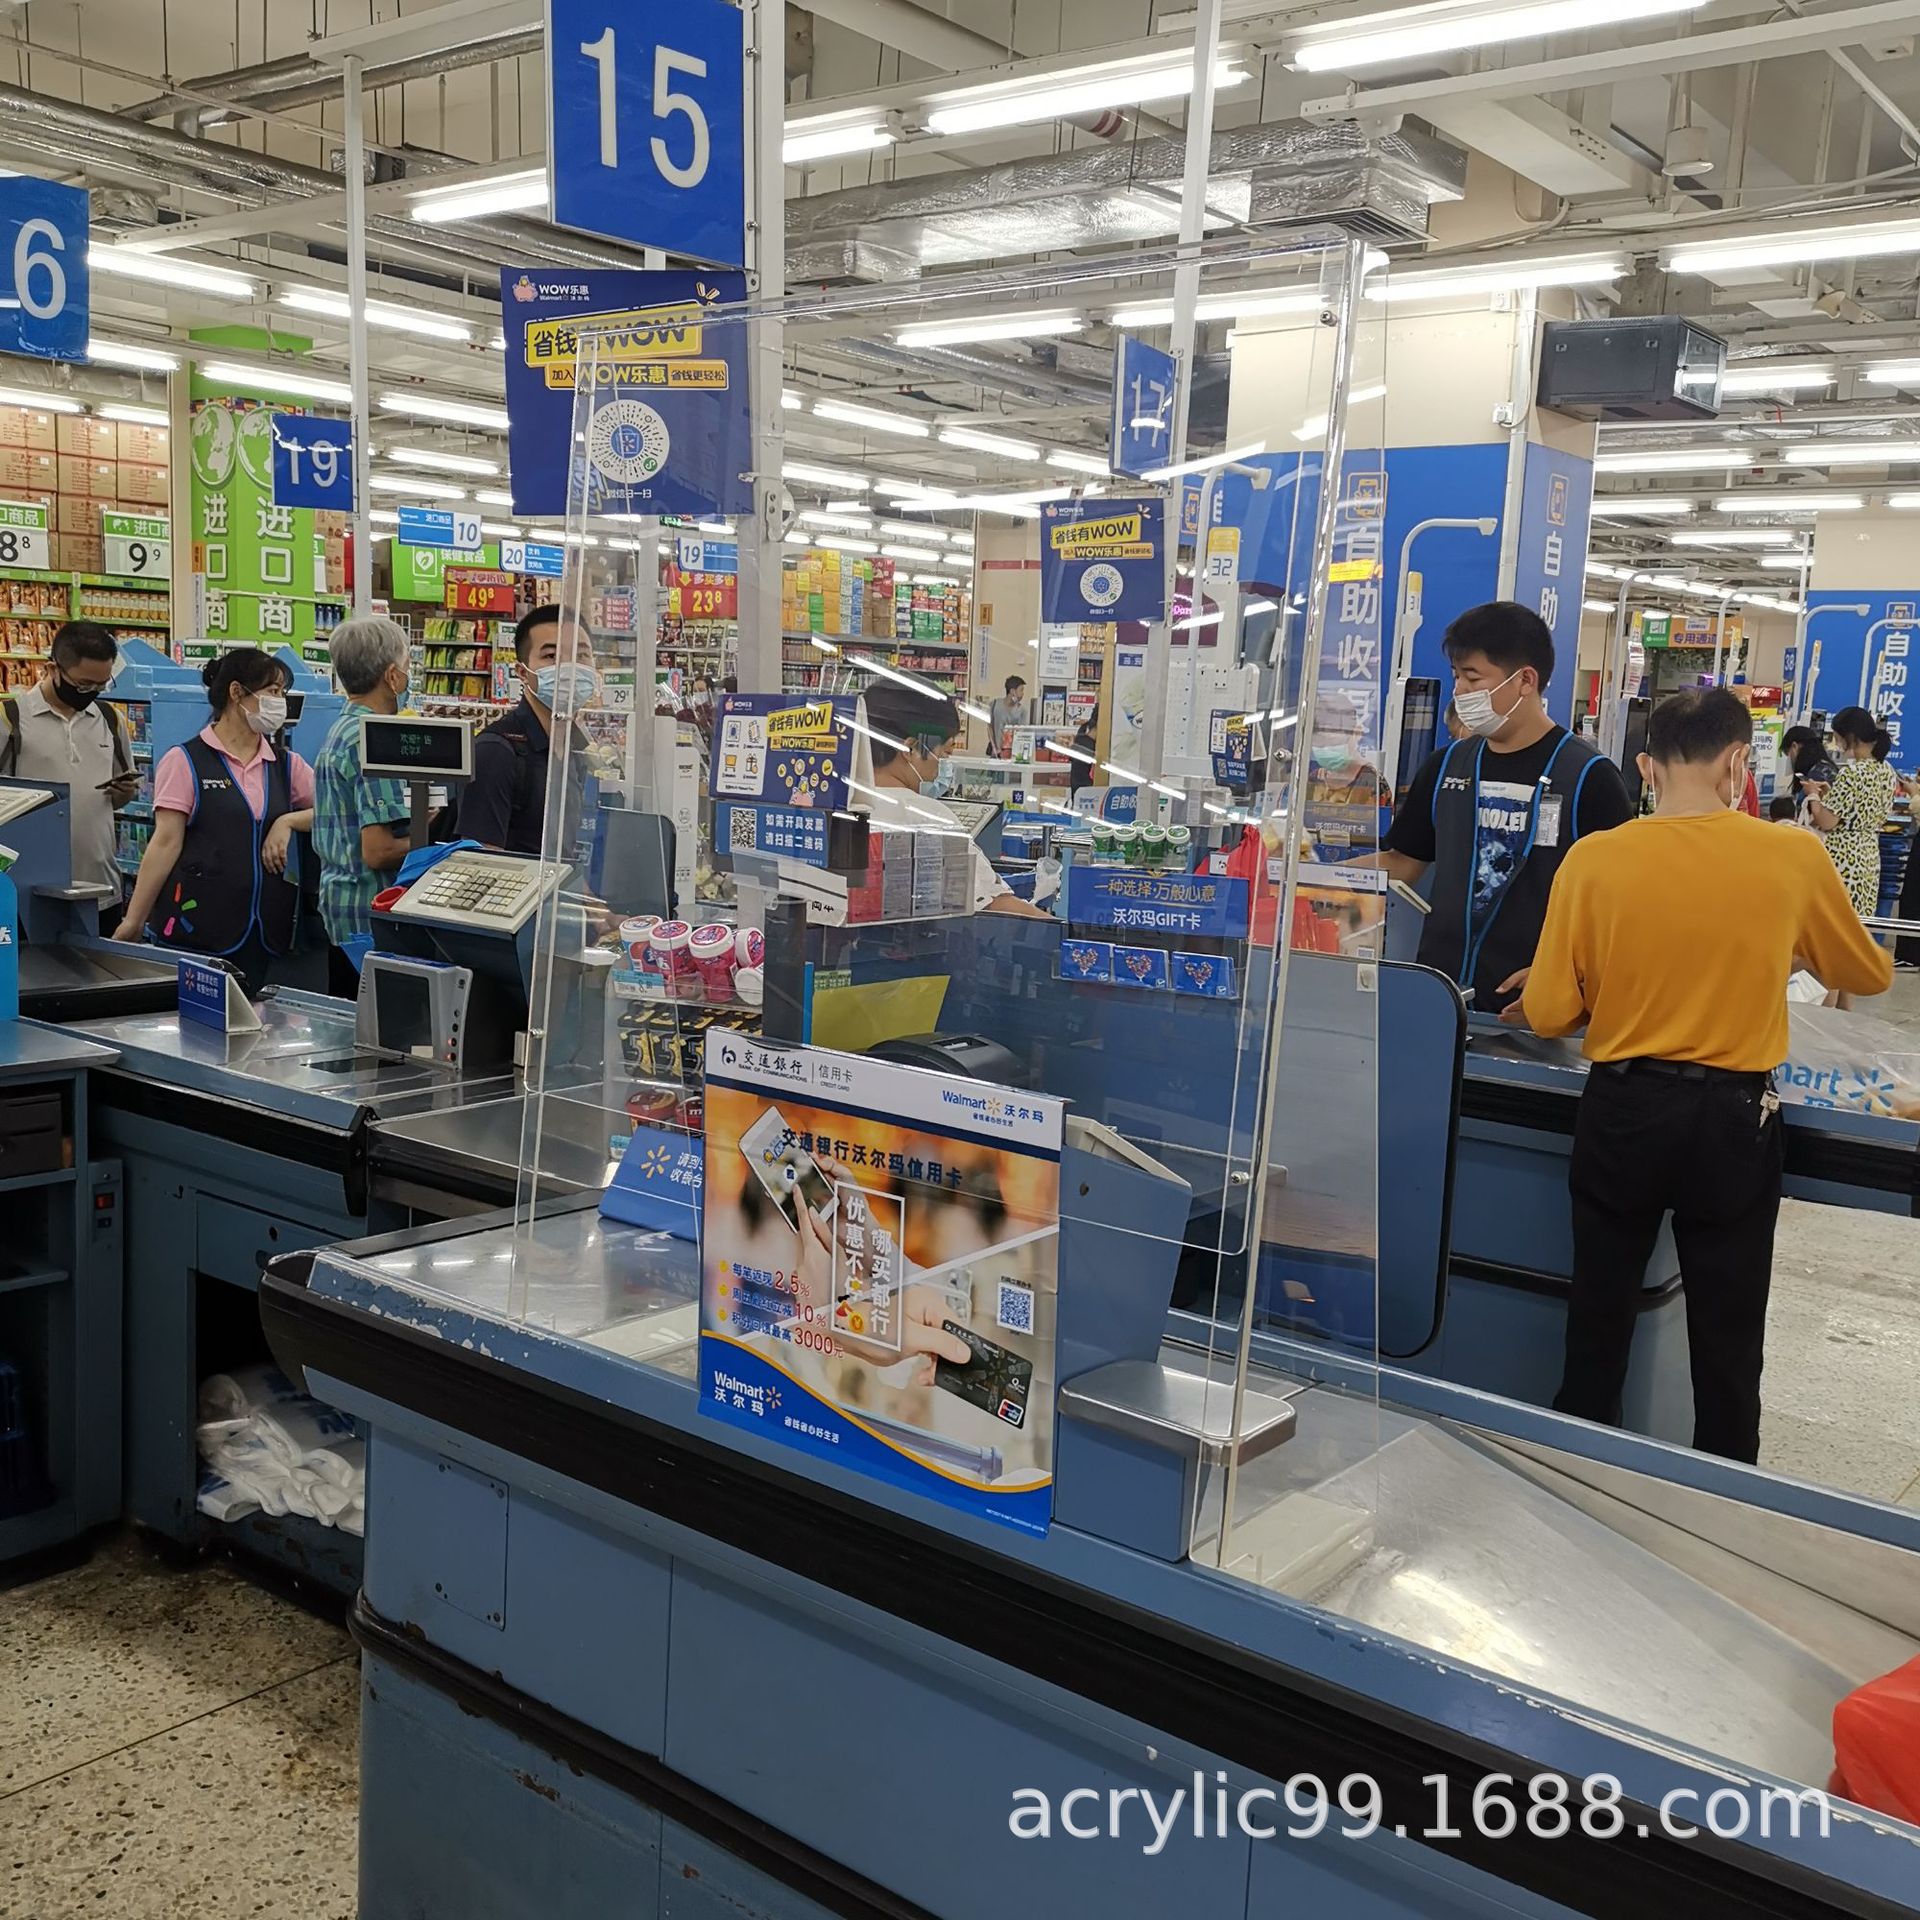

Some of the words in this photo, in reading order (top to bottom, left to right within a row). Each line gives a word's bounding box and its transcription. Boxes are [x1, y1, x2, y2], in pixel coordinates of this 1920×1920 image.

[581, 27, 710, 188] 15
[14, 219, 66, 319] 6
[539, 284, 589, 295] WOW乐惠
[1131, 373, 1166, 449] 17
[284, 436, 338, 489] 19
[459, 522, 478, 542] 10
[1055, 520, 1133, 544] 省钱有WOW
[505, 548, 523, 565] 20
[683, 545, 701, 564] 19
[1212, 558, 1232, 576] 32
[694, 573, 735, 588] 多买多省
[1784, 654, 1795, 671] 38
[766, 813, 824, 832] 如需开具发票
[765, 832, 823, 851] 请扫描二维码
[1113, 908, 1201, 930] 沃尔玛GIFT卡
[738, 1063, 751, 1071] BANK
[762, 1068, 808, 1083] COMMUNICATIONS
[743, 1049, 803, 1074] 交通银行
[818, 1063, 853, 1083] 信用卡
[942, 1090, 987, 1111] Walmart
[1004, 1104, 1044, 1123] 沃尔玛
[781, 1127, 963, 1188] 交通银行沃尔玛信用卡
[871, 1228, 892, 1336] 哪买都行
[714, 1370, 764, 1400] Walmart
[714, 1386, 764, 1417] 沃尔玛
